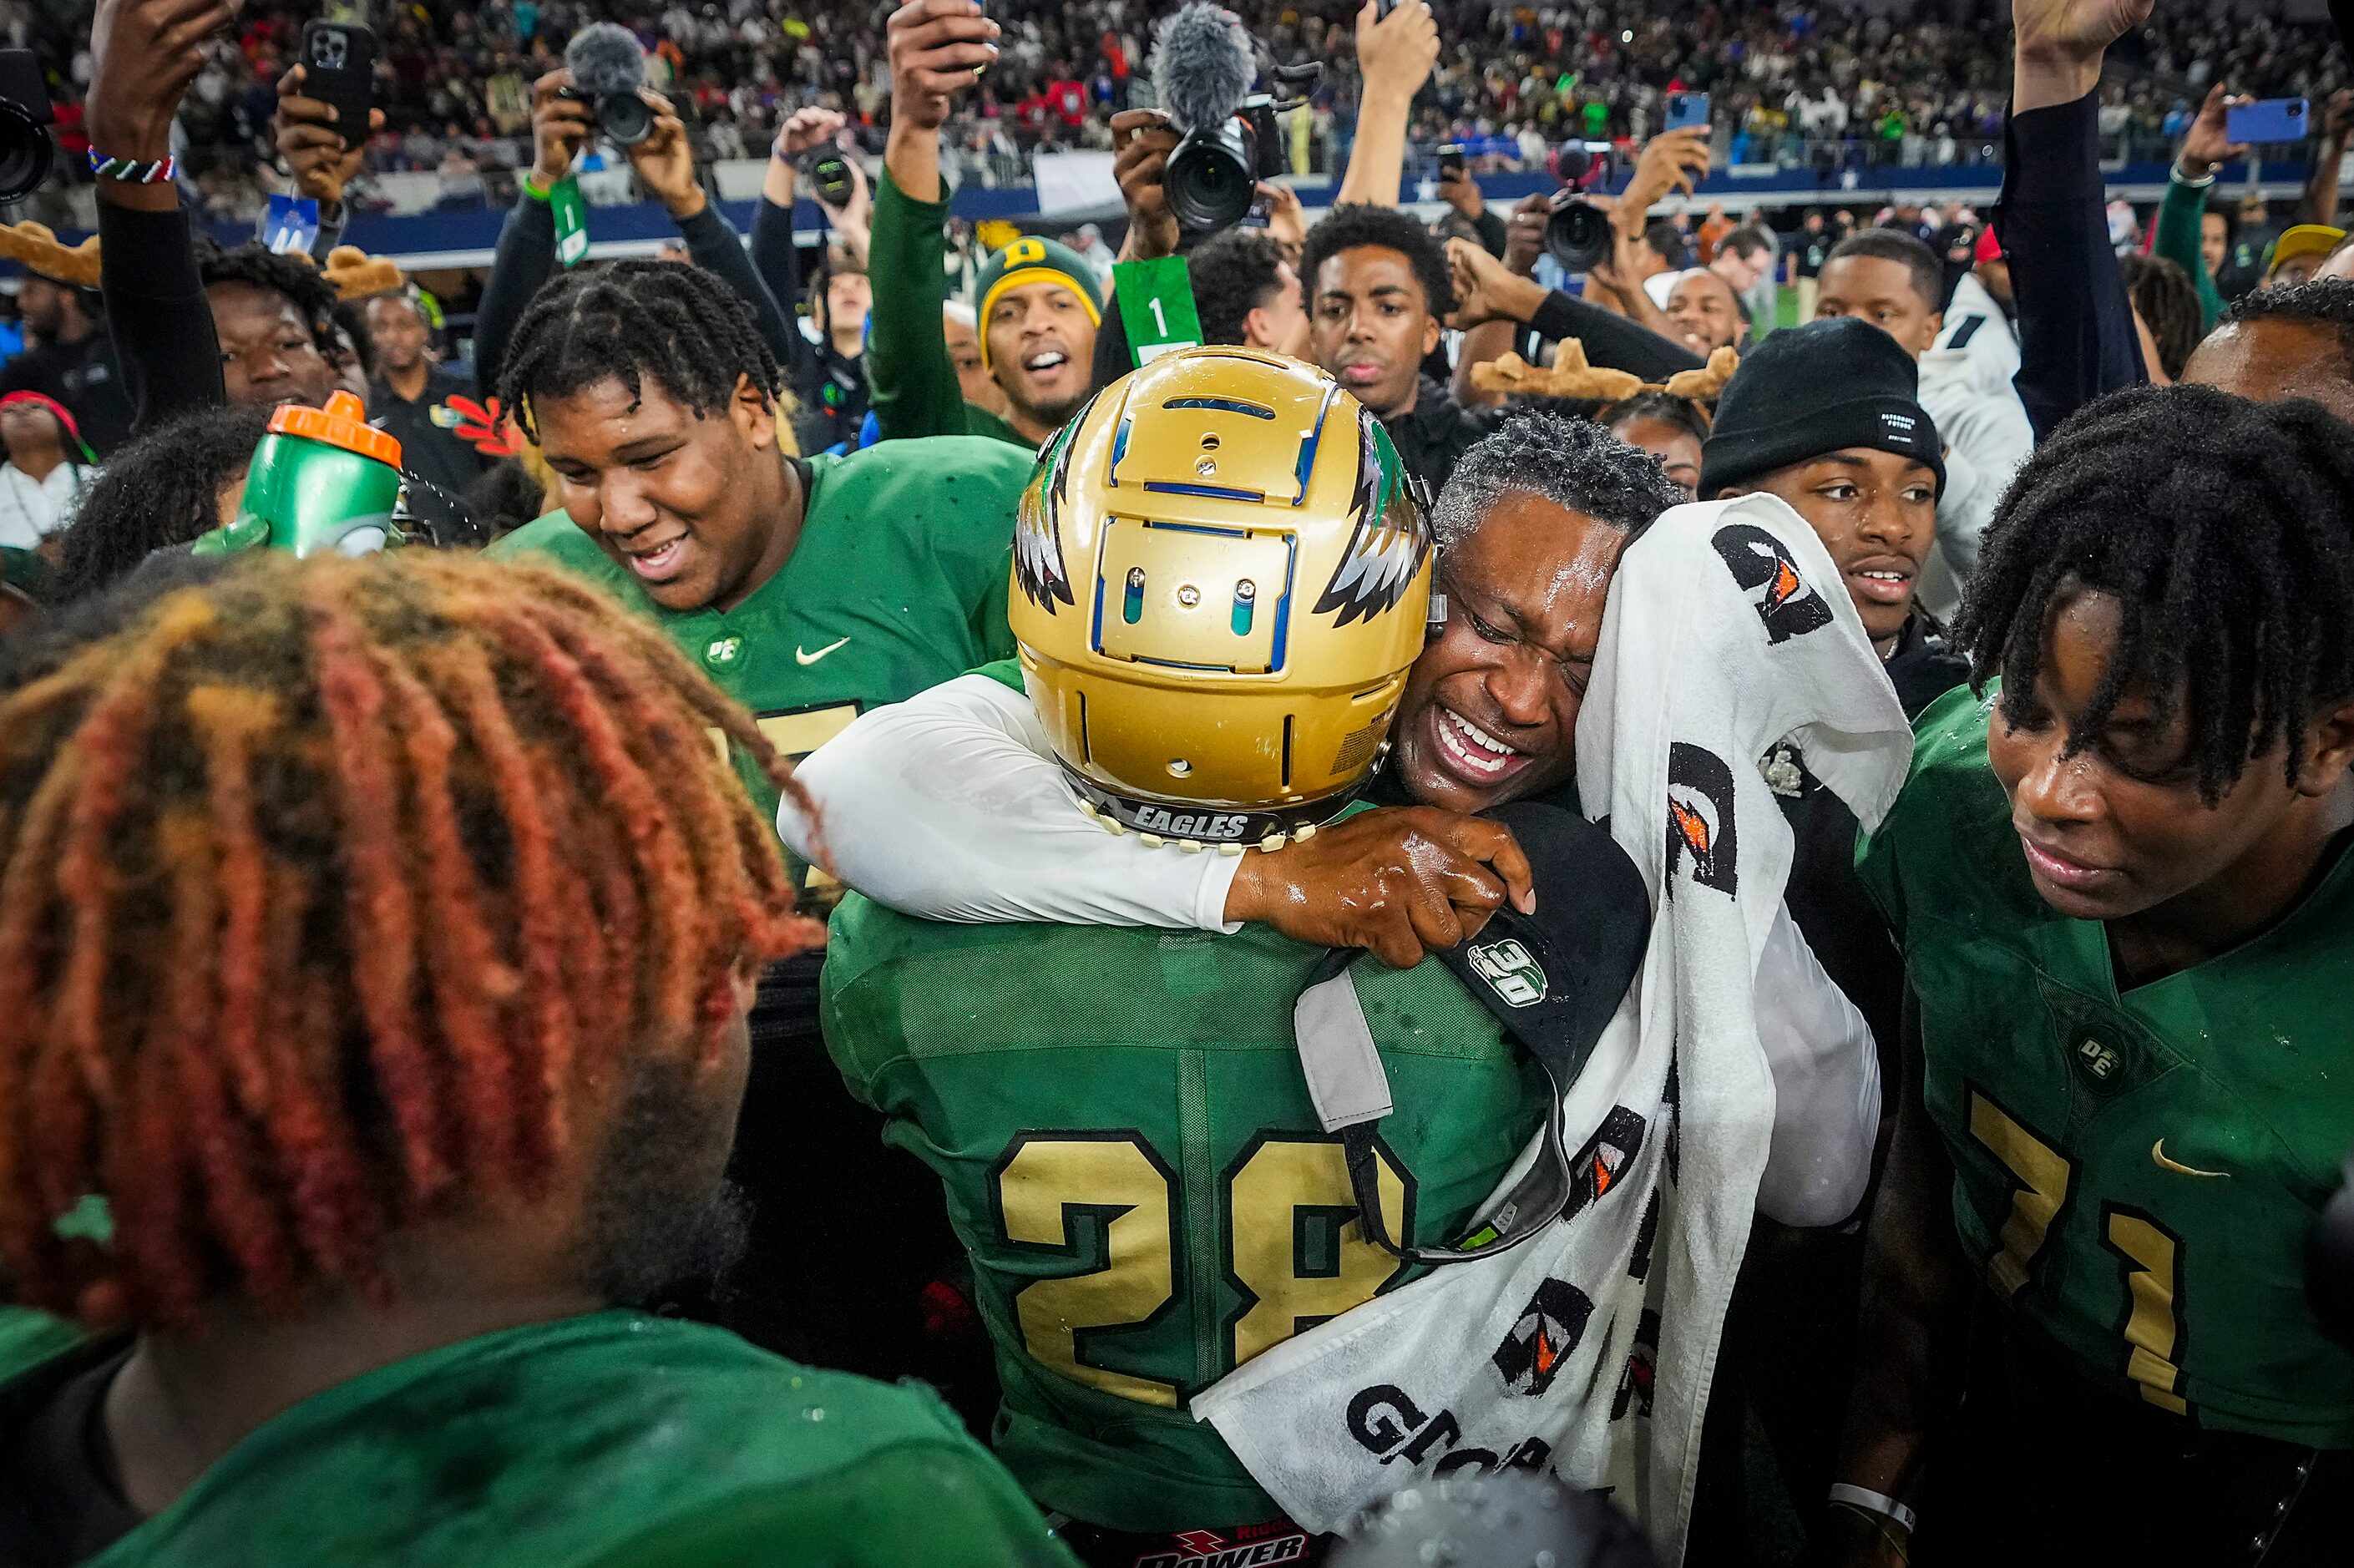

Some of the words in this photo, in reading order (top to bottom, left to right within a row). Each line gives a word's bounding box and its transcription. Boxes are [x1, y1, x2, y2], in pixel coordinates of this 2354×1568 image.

[1004, 238, 1046, 270] D
[1148, 296, 1168, 337] 1
[1134, 805, 1248, 837] EAGLES
[1967, 1079, 2189, 1418] 71
[994, 1131, 1413, 1409] 28
